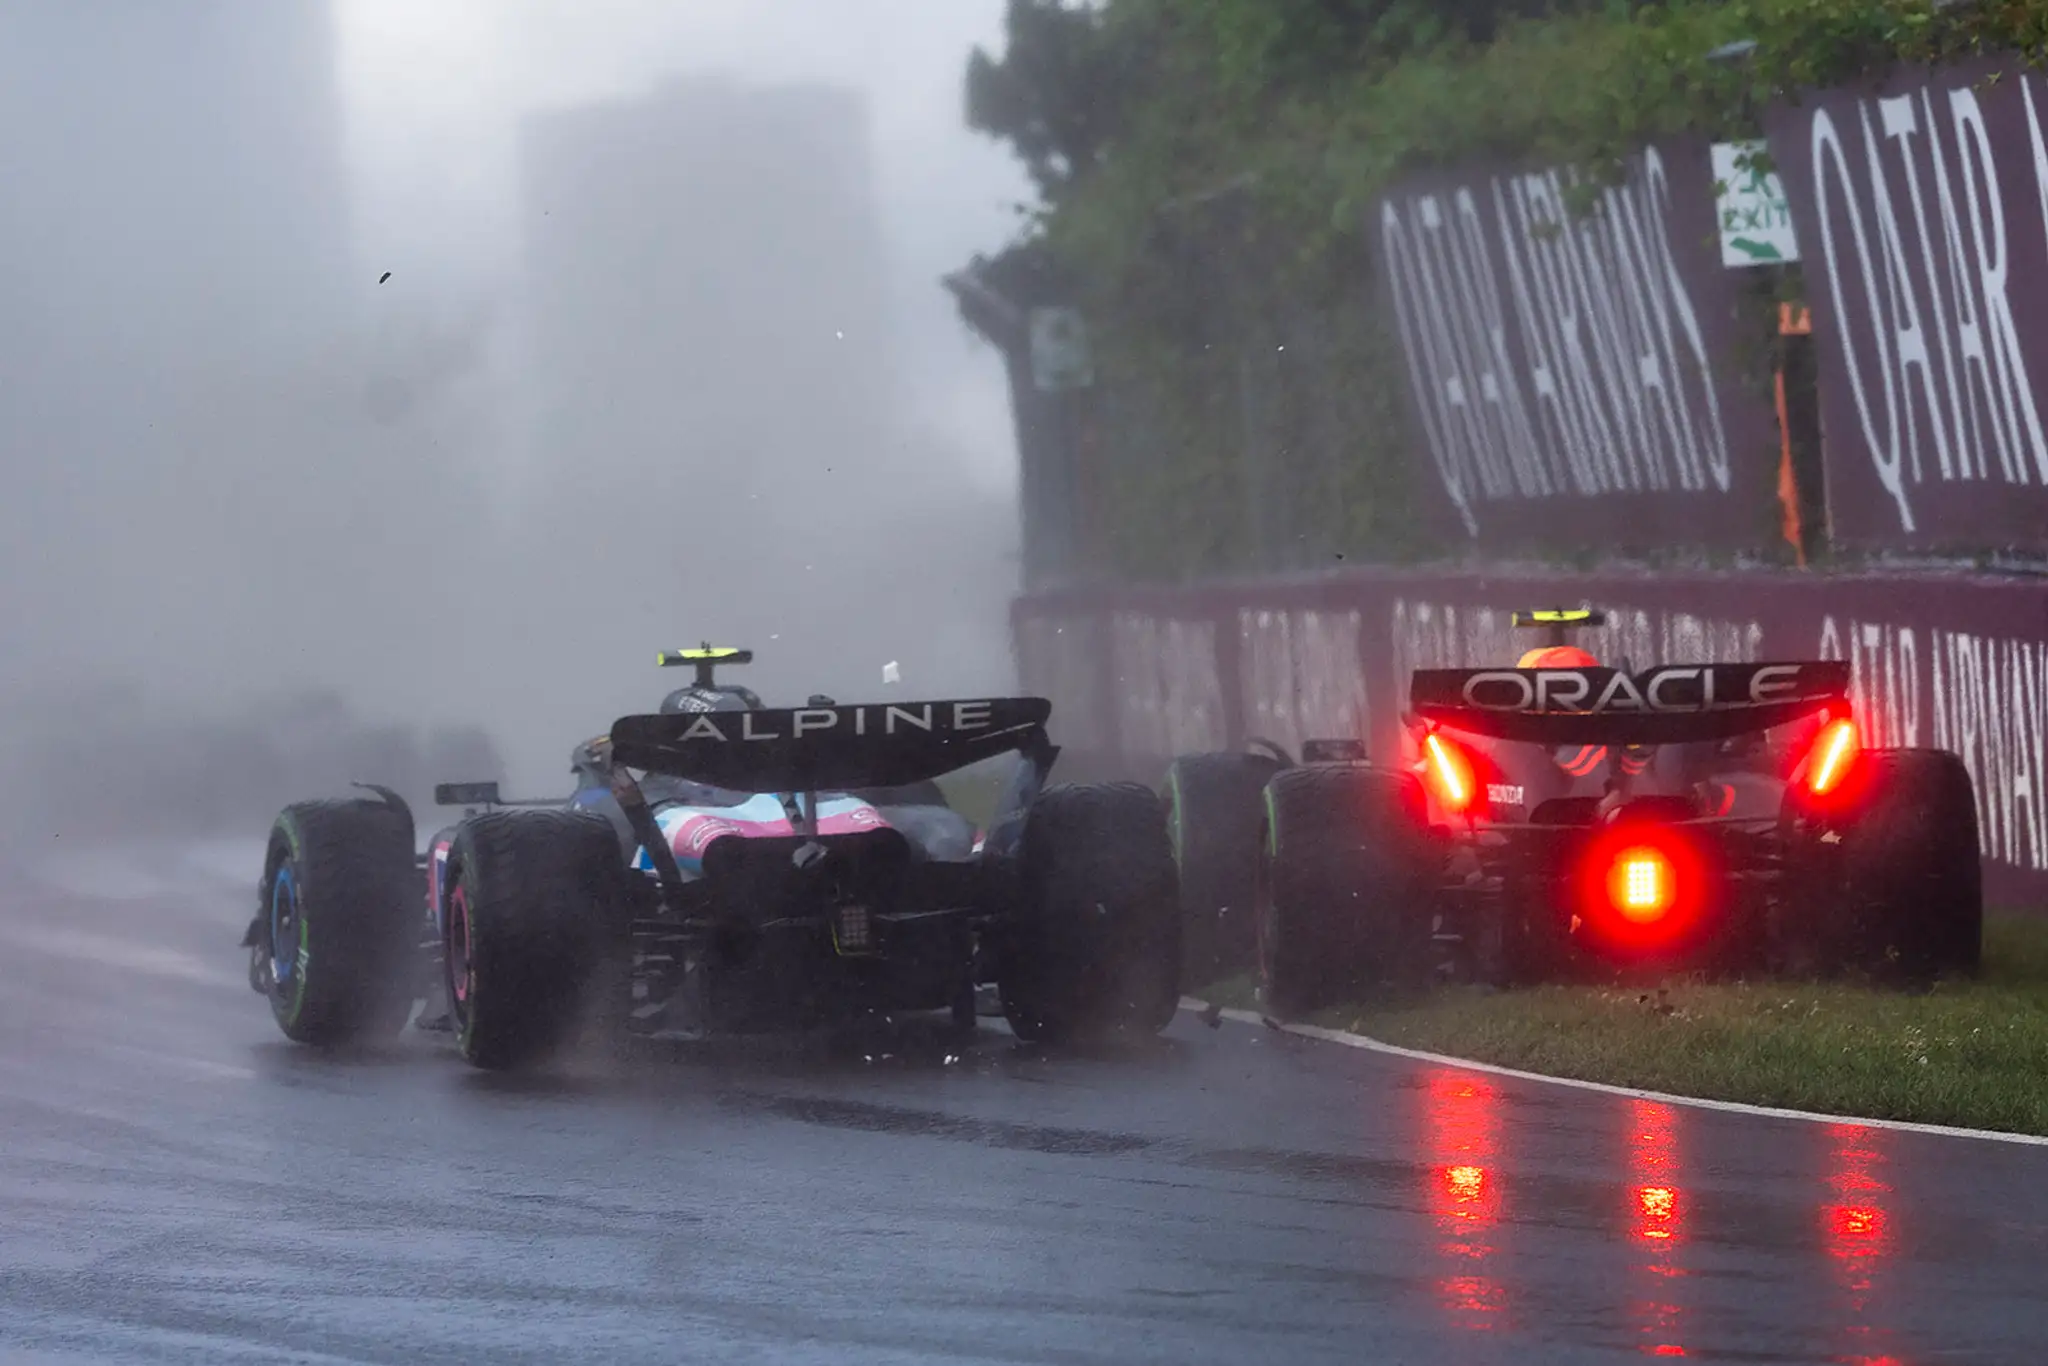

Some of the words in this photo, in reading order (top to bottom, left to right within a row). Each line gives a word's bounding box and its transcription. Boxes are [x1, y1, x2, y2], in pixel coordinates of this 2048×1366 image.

[1723, 200, 1788, 232] EXIT
[1811, 86, 2048, 532] QATAR
[1462, 665, 1803, 713] ORACLE
[677, 701, 991, 741] ALPINE
